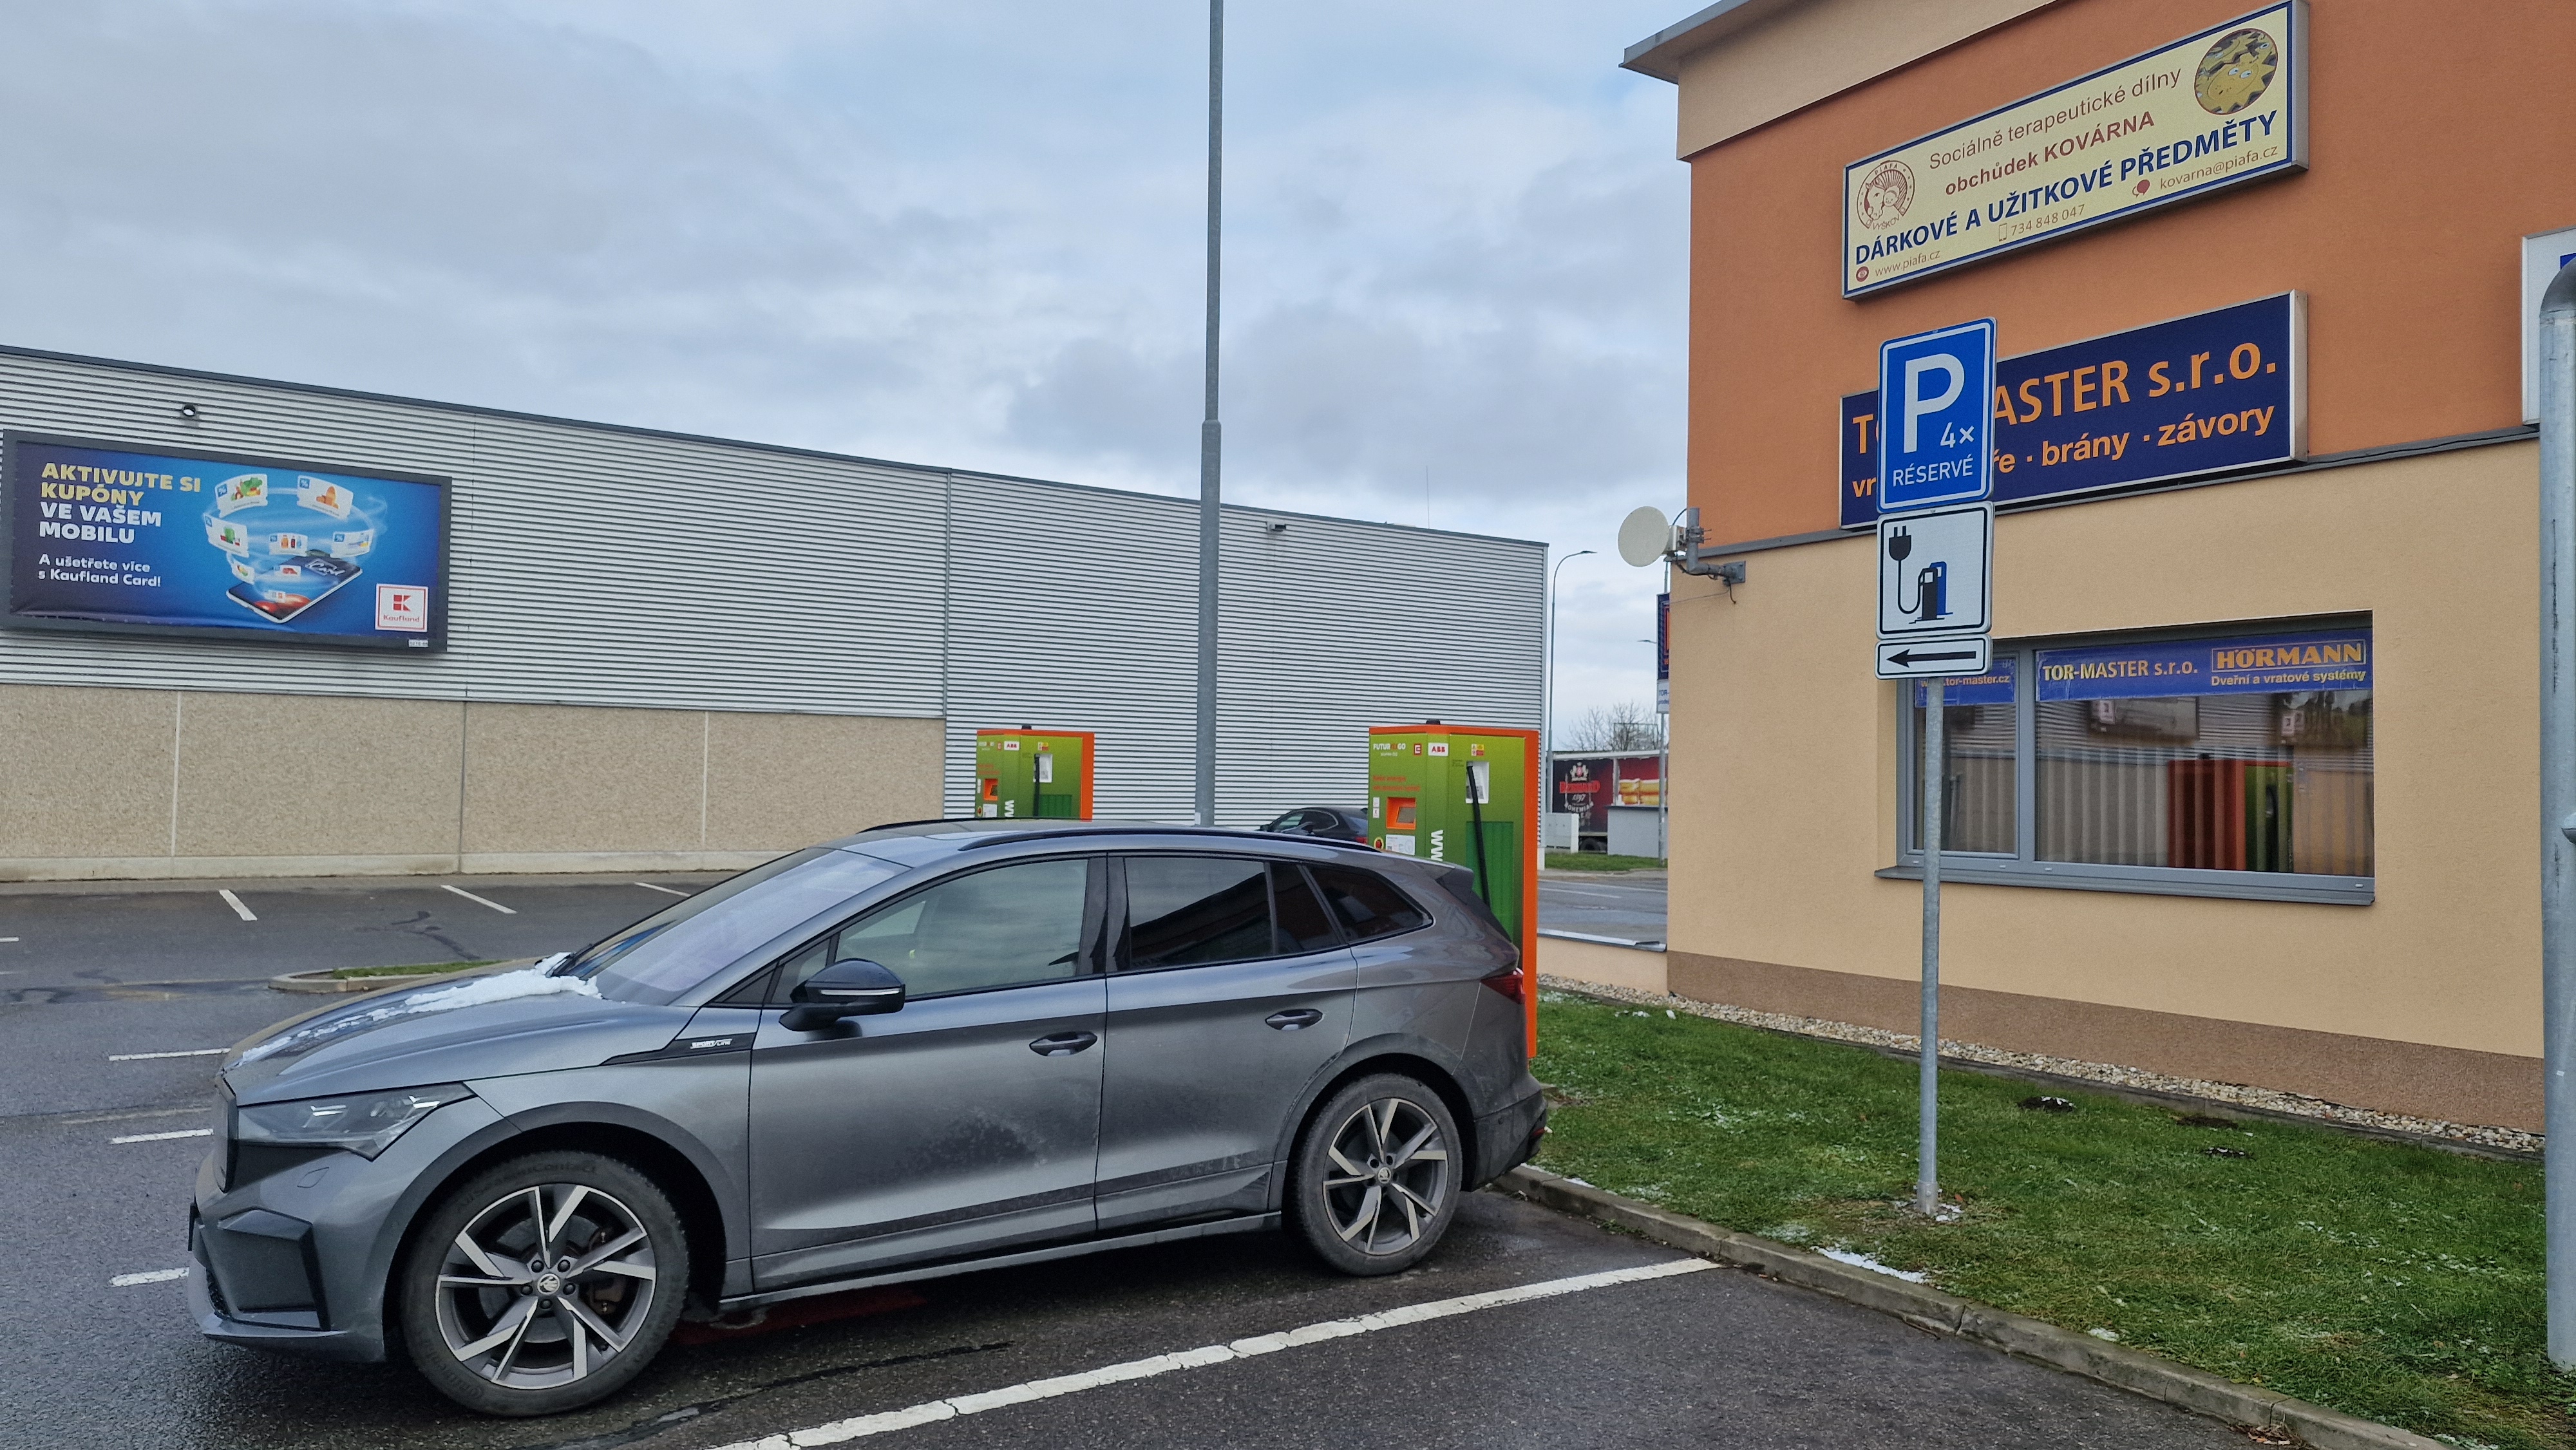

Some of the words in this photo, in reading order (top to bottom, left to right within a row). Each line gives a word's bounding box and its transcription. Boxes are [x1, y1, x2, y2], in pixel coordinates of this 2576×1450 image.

[1929, 130, 2003, 170] Sociálně
[2008, 86, 2126, 144] terapeutické
[2132, 68, 2181, 97] dílny
[1946, 153, 2038, 195] obchůdek
[2045, 111, 2154, 164] KOVÁRNA
[1875, 164, 1898, 175] PIAFA
[2160, 146, 2278, 191] kovarna@piafa.cz
[1856, 212, 1958, 265] DÁRKOVÉ
[1965, 207, 1981, 231] A
[1988, 160, 2113, 223] UŽITKOVÉ
[2121, 111, 2278, 181] PŘEDMĚTY
[1873, 214, 1899, 231] VYŠKOV
[2011, 219, 2033, 237] 734
[2035, 212, 2060, 231] 848
[2062, 203, 2085, 225] 047
[1875, 250, 1940, 277] www.piafa.cz
[1853, 359, 2130, 453] TASTER
[2149, 343, 2277, 397] s.r.o.
[1904, 353, 1965, 453] P
[2042, 431, 2130, 467] brány
[2159, 406, 2275, 447] závory
[42, 462, 173, 490] AKTIVUJTE
[180, 476, 201, 492] SI
[1893, 453, 1974, 487] RÉSERVÉ
[41, 482, 144, 506] KUPÓNY
[40, 501, 72, 520] VE
[80, 504, 162, 527] VAŠEM
[39, 521, 135, 544] MOBILU
[39, 553, 51, 566] A
[55, 556, 118, 571] ušetřete
[122, 561, 151, 572] více
[37, 570, 46, 580] s
[50, 568, 118, 585] Kaufland
[123, 574, 161, 587] Card!
[2217, 643, 2362, 669] HÖRMANN
[1921, 675, 2010, 688] w.tor-master.cz
[2043, 660, 2148, 681] TOR-MASTER
[2154, 662, 2198, 677] s.r.o.
[2211, 674, 2249, 686] Dveřní
[2264, 671, 2309, 683] vratové
[2313, 671, 2366, 683] systémy
